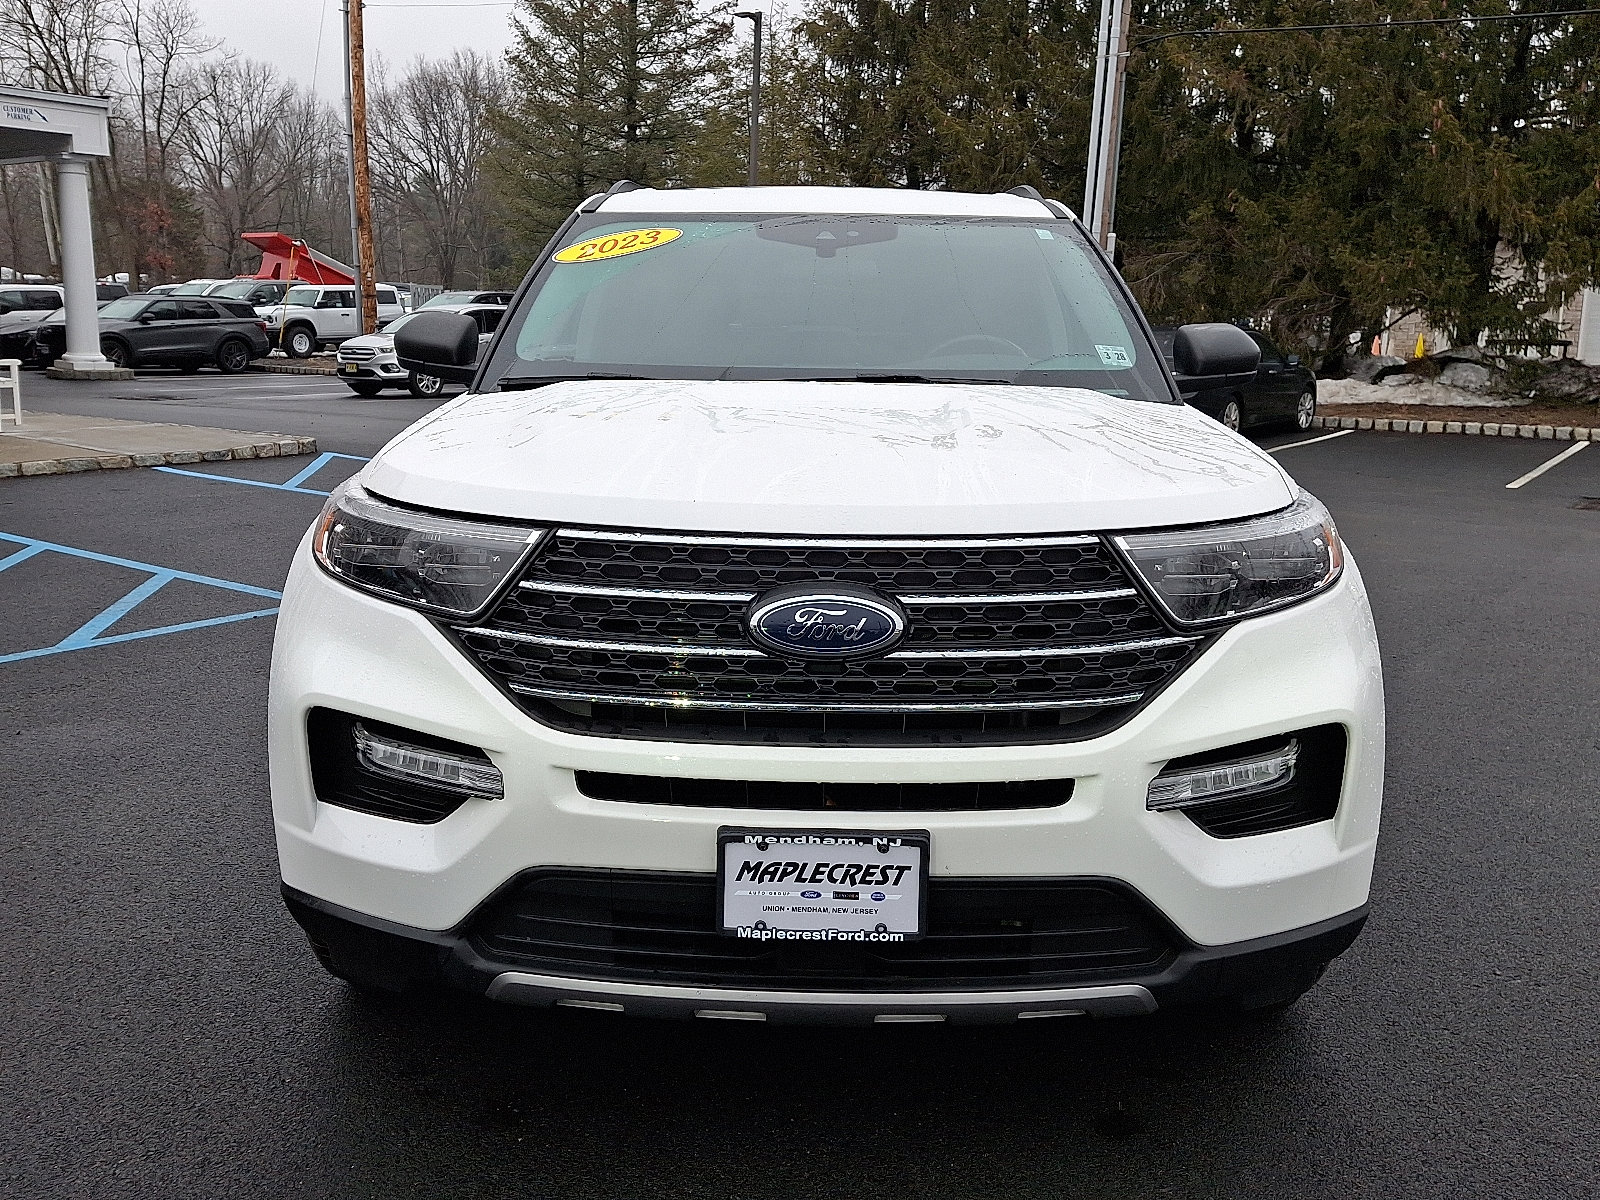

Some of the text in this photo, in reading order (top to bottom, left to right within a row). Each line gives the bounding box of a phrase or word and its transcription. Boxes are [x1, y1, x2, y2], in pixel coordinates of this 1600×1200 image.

[2, 105, 34, 115] CUSTOMER
[6, 112, 31, 121] PARKING
[576, 230, 662, 260] 2023
[1103, 351, 1127, 361] 3 28
[786, 607, 868, 641] Ford
[744, 835, 902, 847] Mendham, NJ
[734, 860, 913, 887] MAPLECREST
[791, 906, 831, 914] MENDHAM,
[737, 926, 904, 942] MaplecrestFord.com
